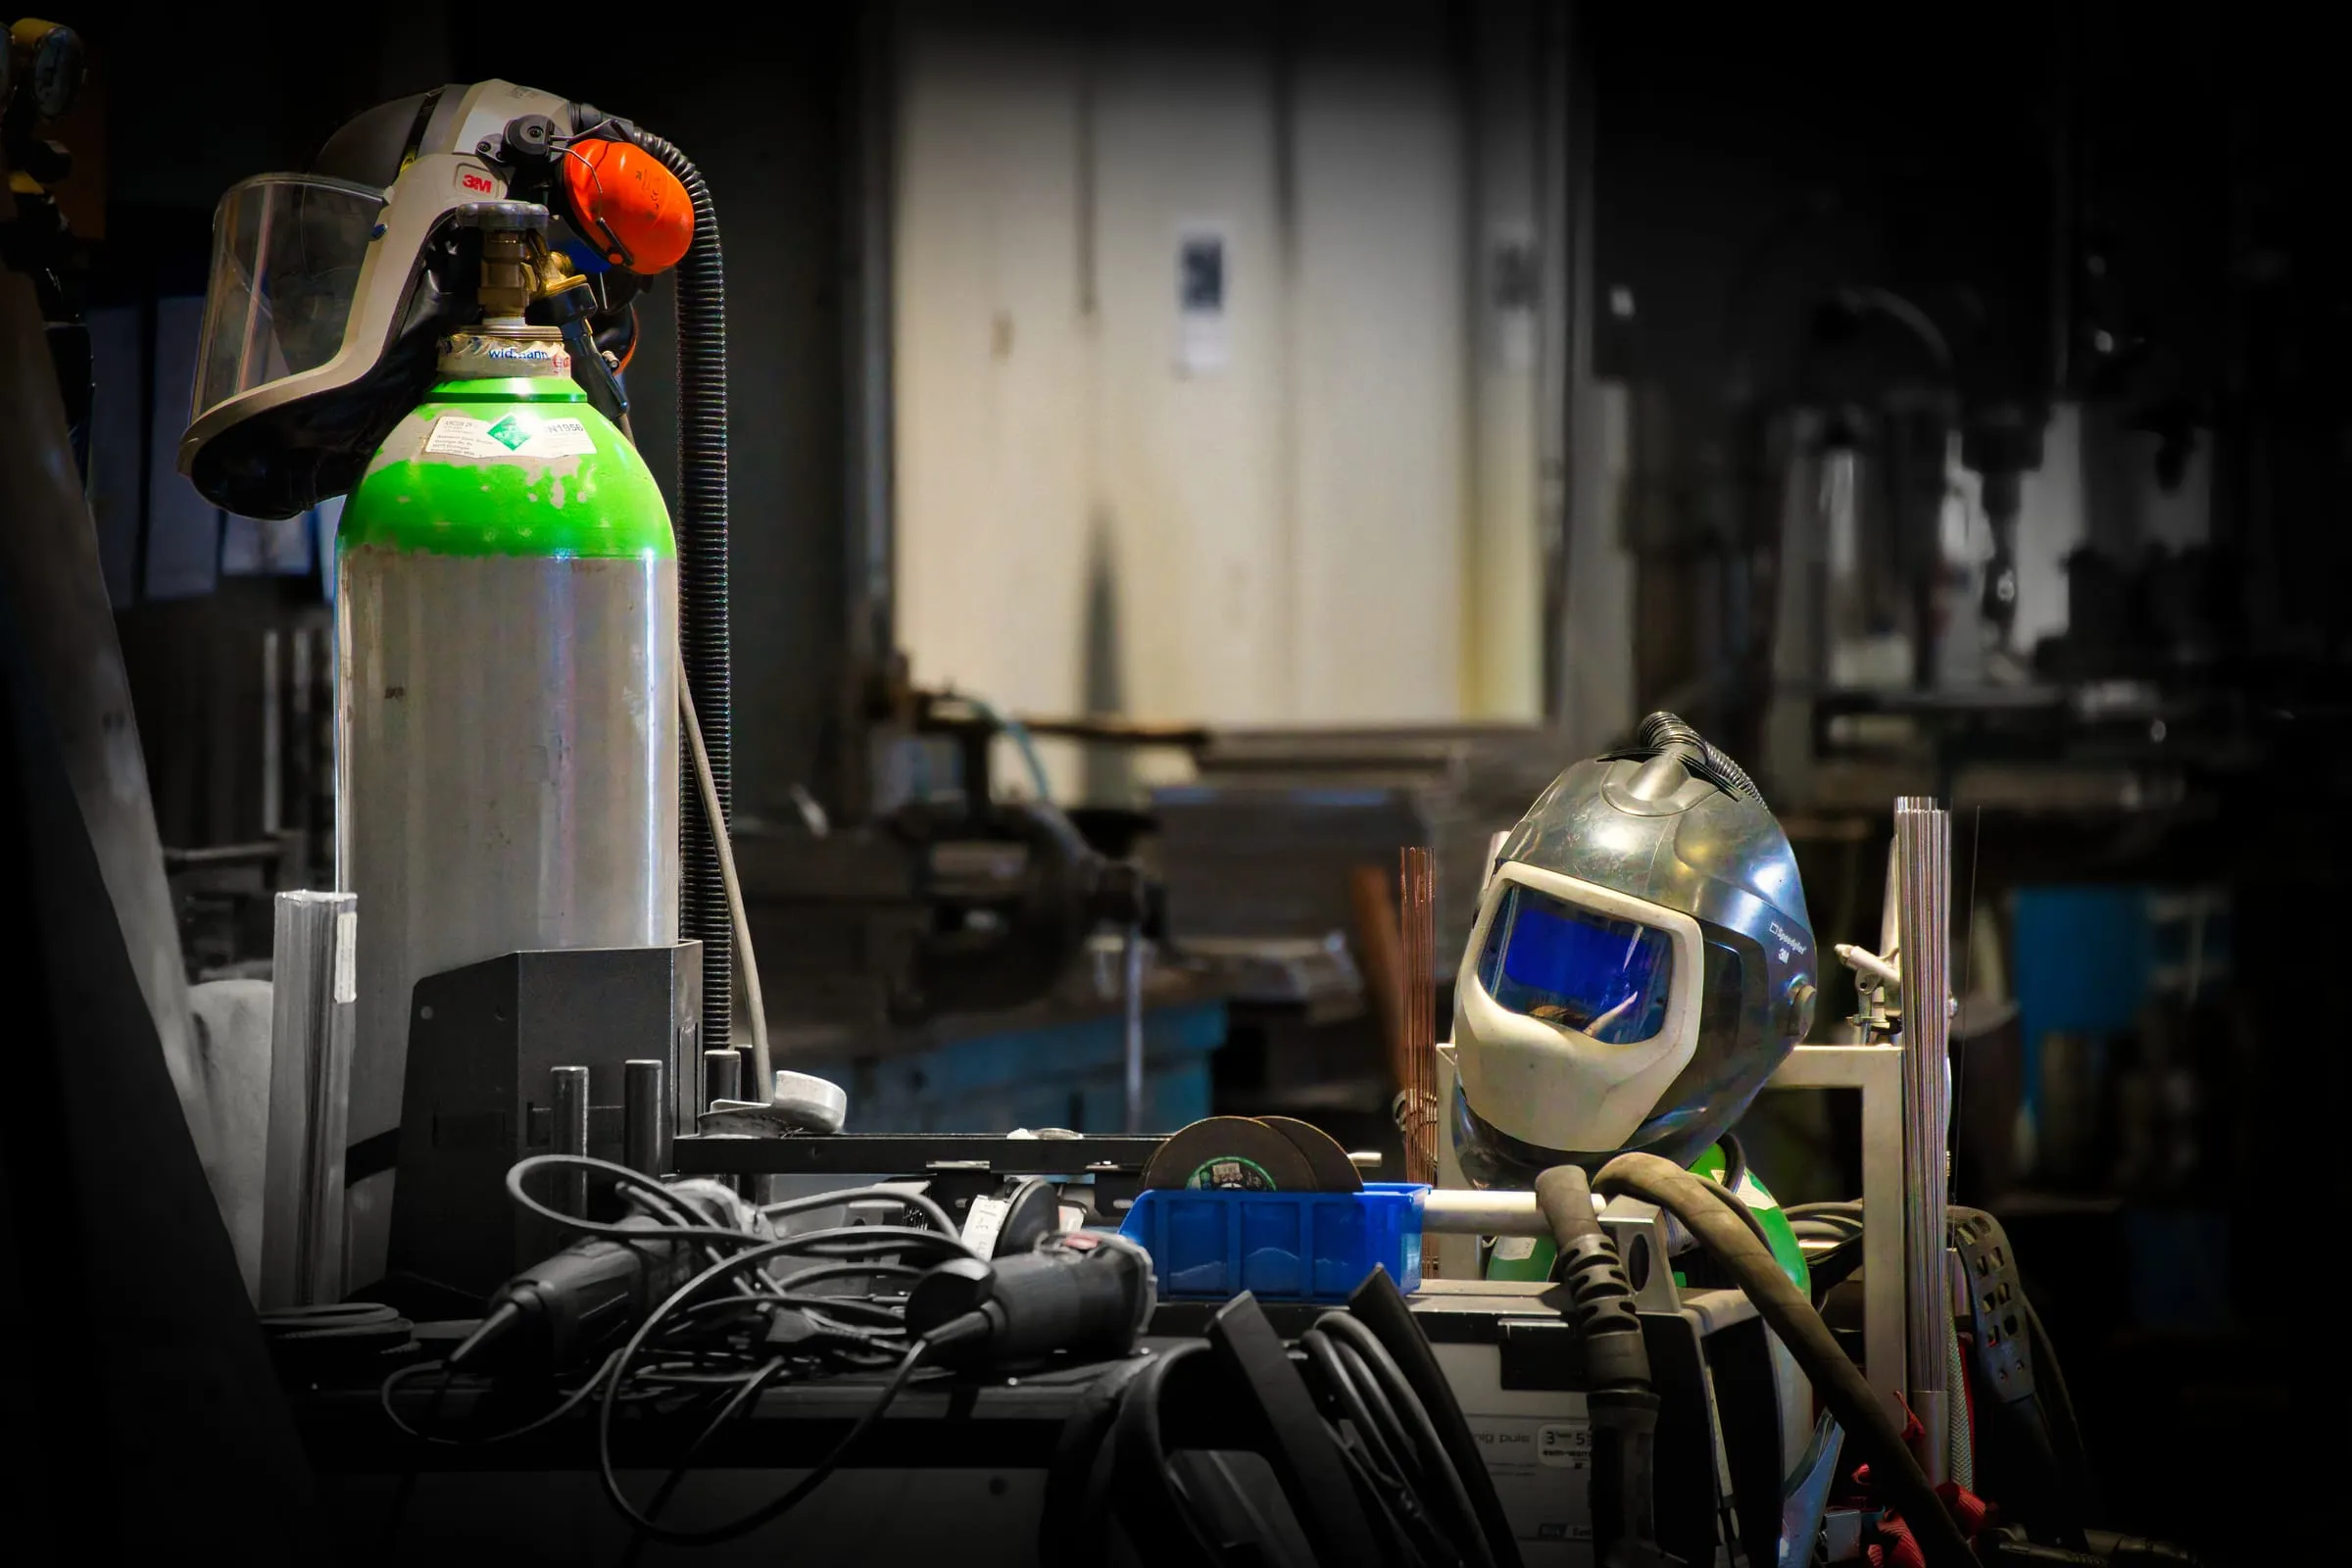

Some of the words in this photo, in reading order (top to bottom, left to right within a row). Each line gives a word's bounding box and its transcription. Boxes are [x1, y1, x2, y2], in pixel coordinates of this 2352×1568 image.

[463, 173, 492, 193] 3M
[1545, 1431, 1554, 1445] 3
[1576, 1432, 1585, 1446] 5
